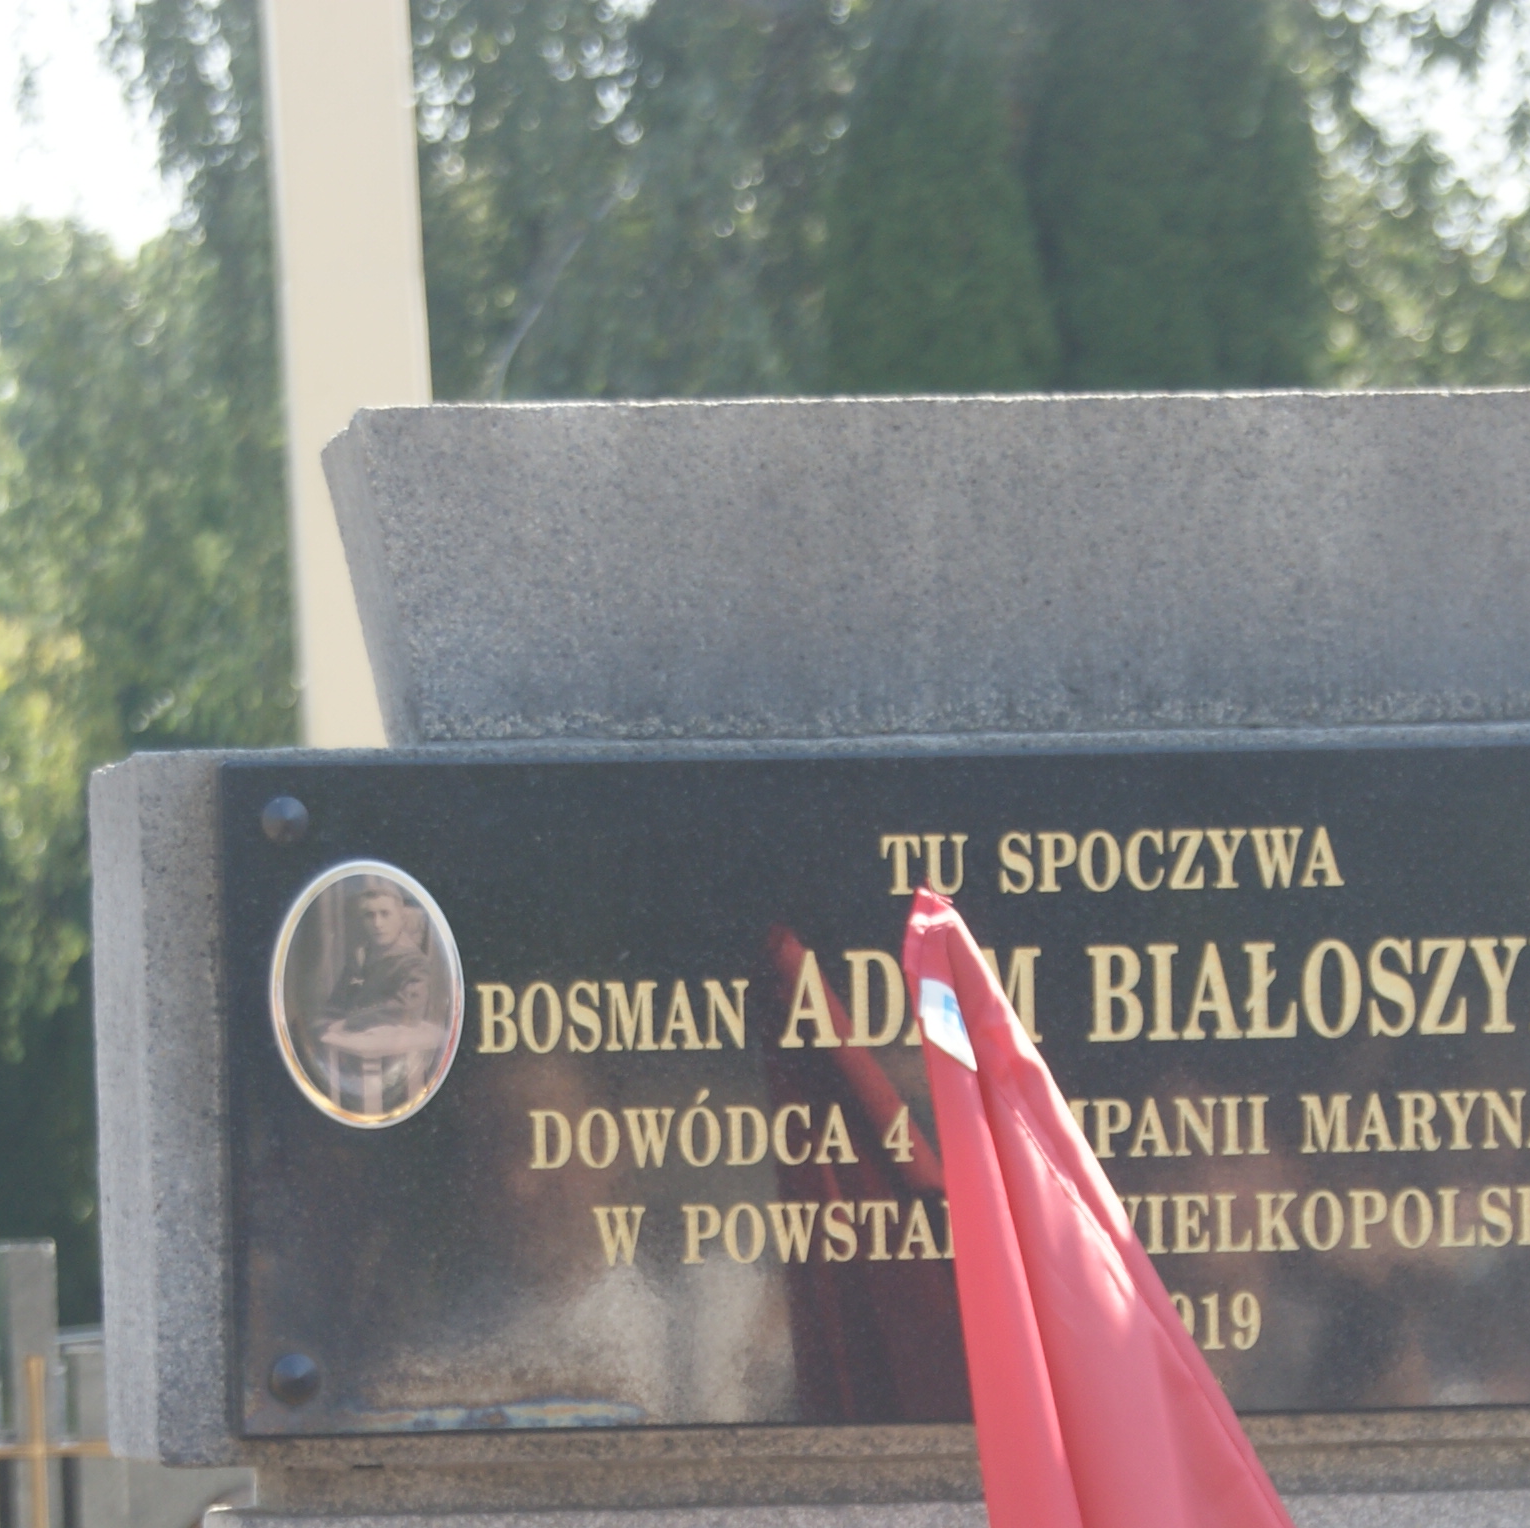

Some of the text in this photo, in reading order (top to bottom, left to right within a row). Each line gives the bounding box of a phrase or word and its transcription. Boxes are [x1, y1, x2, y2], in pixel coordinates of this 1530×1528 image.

[880, 828, 1345, 895] TU SPOCZYWA
[475, 979, 749, 1054] BOSMAN
[779, 946, 1042, 1048] ADM
[527, 1088, 858, 1170] DOWÓDCA
[883, 1105, 914, 1162] 4
[1069, 1094, 1269, 1159] PANII
[590, 1205, 645, 1266] W
[681, 1200, 953, 1263] POWSTA
